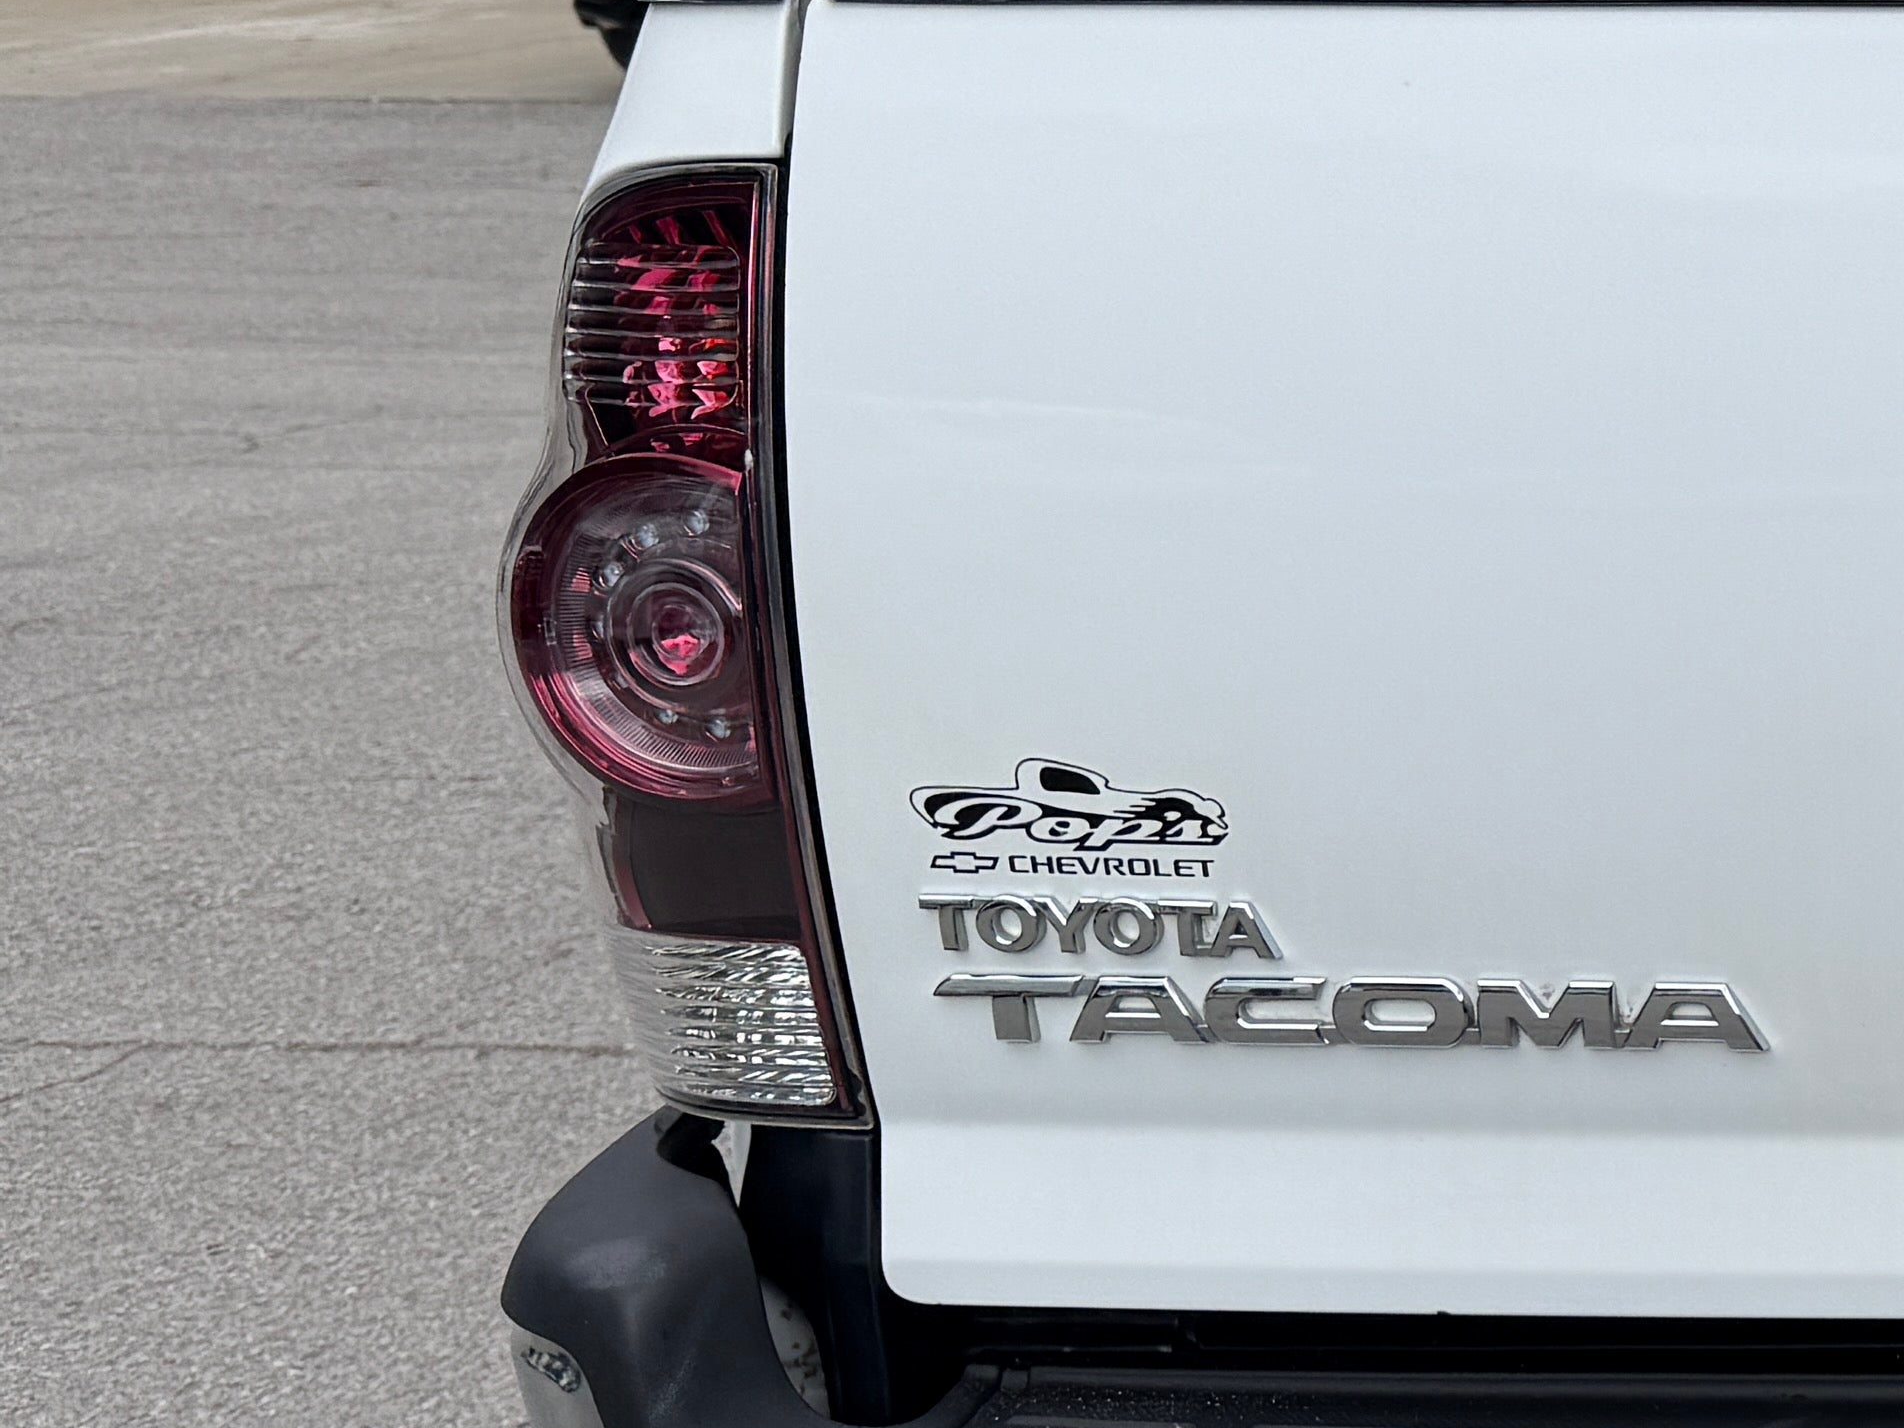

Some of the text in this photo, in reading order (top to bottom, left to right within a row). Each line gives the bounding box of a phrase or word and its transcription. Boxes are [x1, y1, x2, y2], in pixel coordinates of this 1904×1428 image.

[1008, 854, 1215, 878] CHEVROLET
[917, 892, 1284, 960] TOYOTA
[932, 973, 1772, 1053] TACOMA
